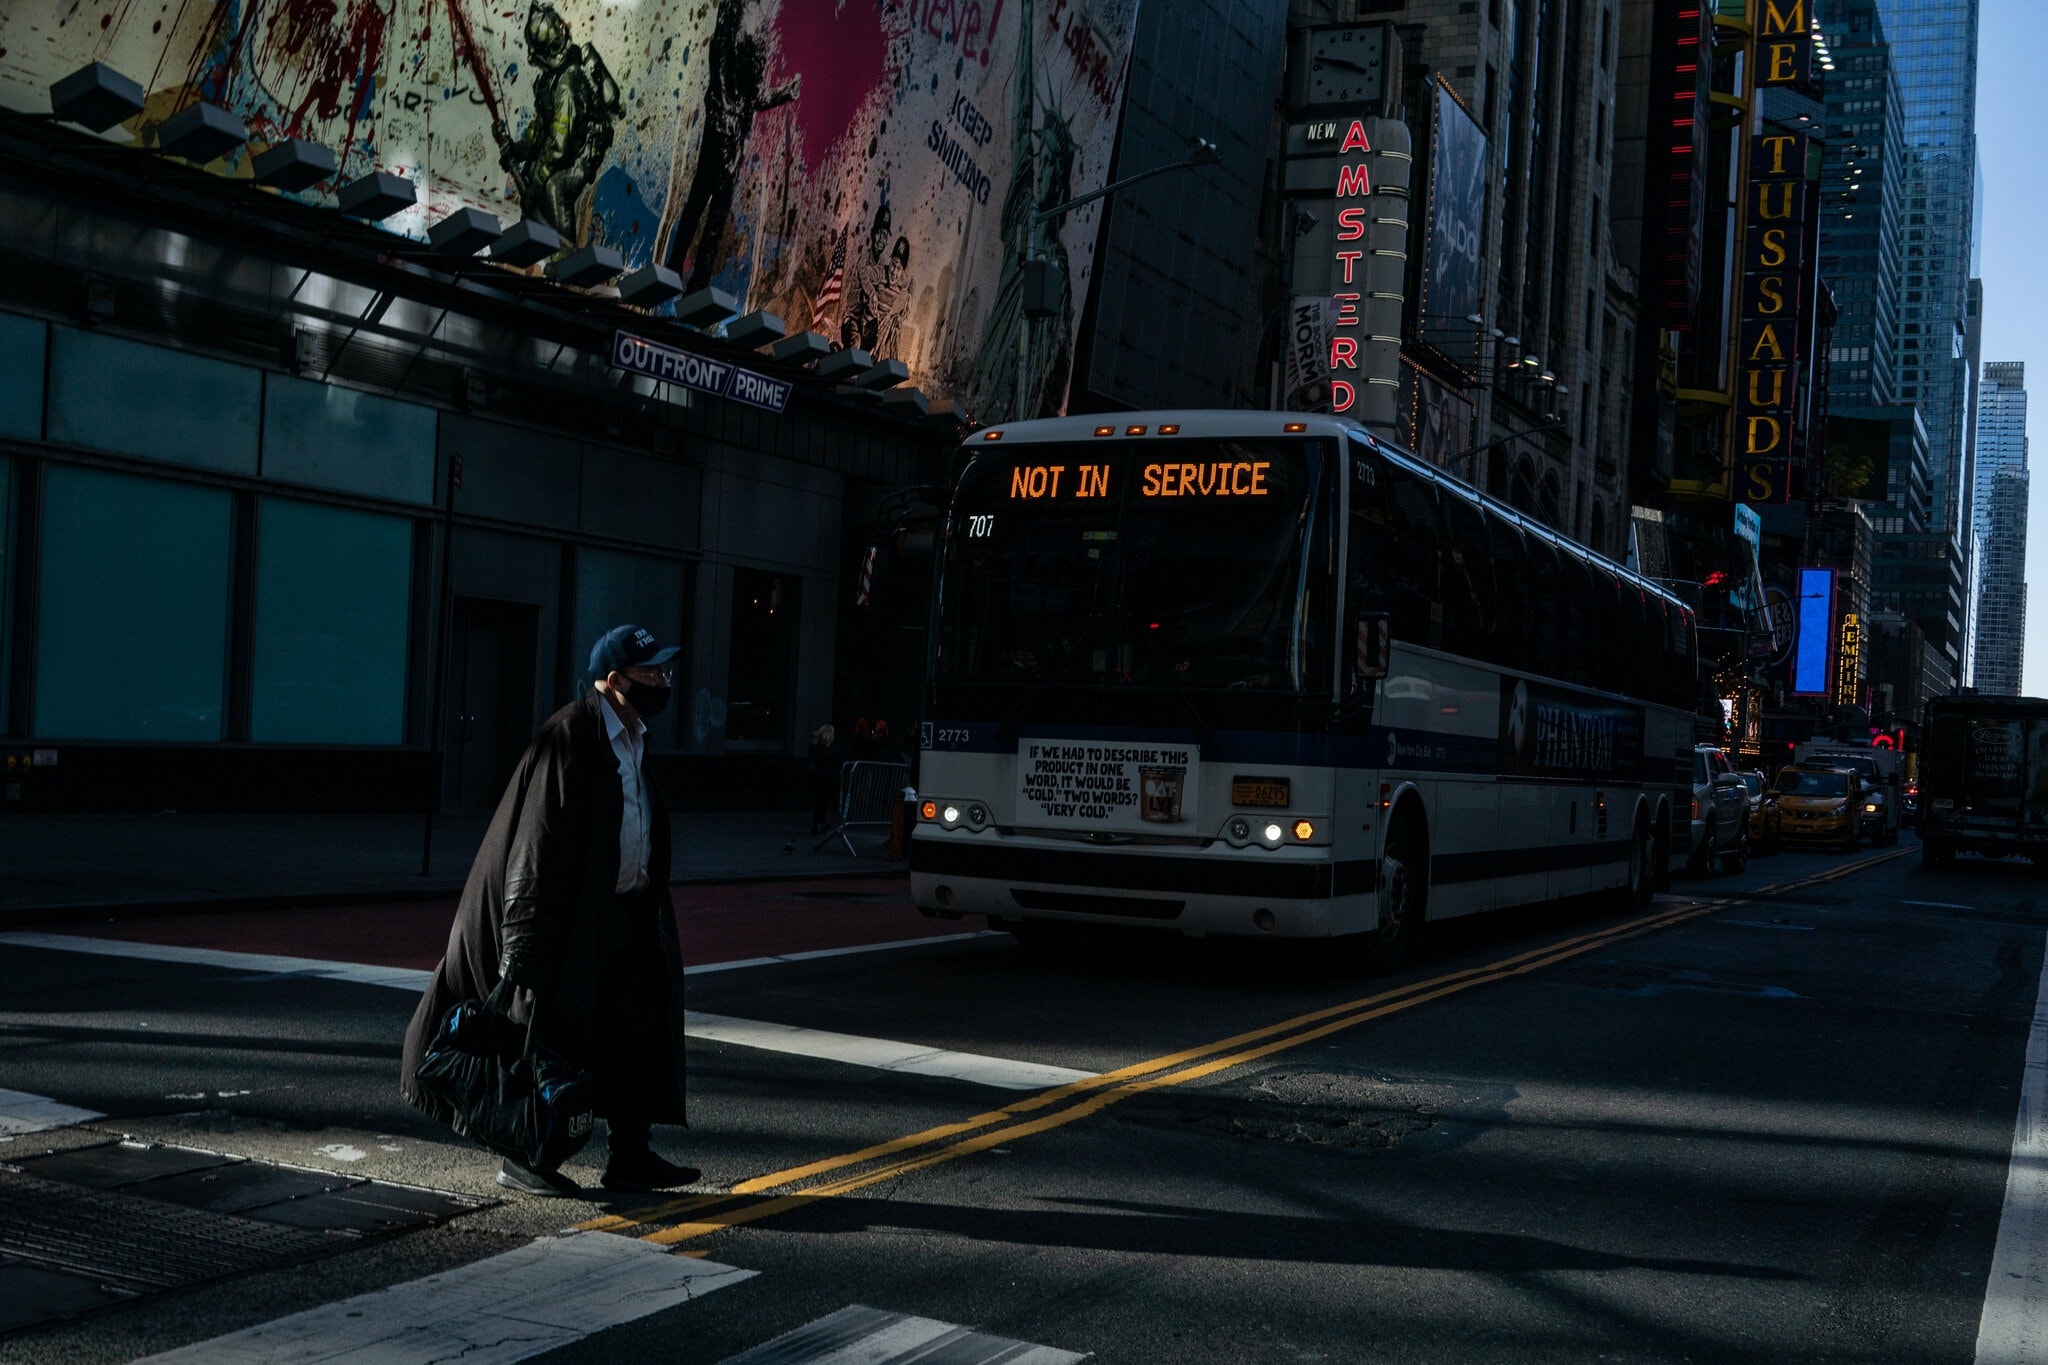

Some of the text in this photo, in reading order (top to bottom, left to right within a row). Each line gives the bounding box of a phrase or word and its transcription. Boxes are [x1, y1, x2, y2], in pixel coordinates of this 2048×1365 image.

[1342, 32, 1352, 42] 12
[1340, 89, 1348, 100] 6
[951, 89, 992, 147] KEEP
[1307, 123, 1337, 140] NEW
[928, 120, 991, 206] SMILING
[1435, 204, 1477, 263] ALDO
[619, 338, 785, 408] OUTFRONT PRIME
[1010, 462, 1270, 499] NOT IN SERVICE
[969, 514, 994, 538] 707
[938, 728, 970, 742] 2773
[1533, 704, 1614, 770] PHANTOM
[1030, 745, 1189, 764] IF WE HAD TO DESCRIBE THIS
[1035, 760, 1124, 776] PRODUCT IN ONE
[1026, 774, 1130, 791] WORD, IT WOULD BE
[1064, 790, 1089, 803] TWO
[1092, 792, 1138, 806] WORDS?
